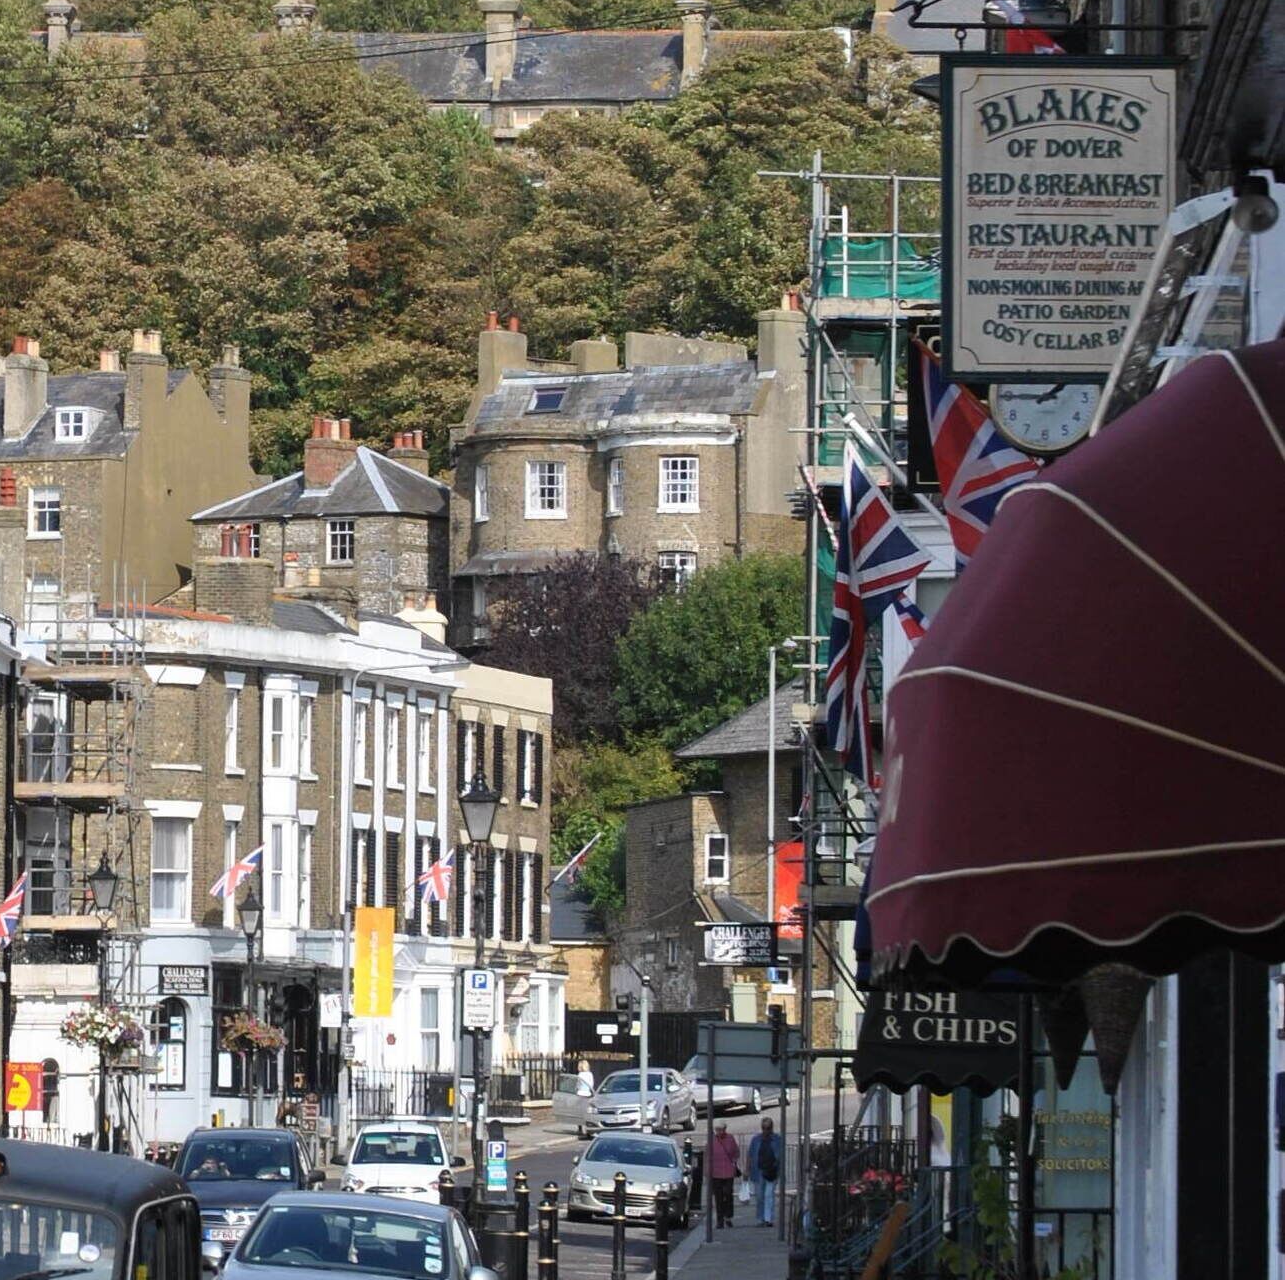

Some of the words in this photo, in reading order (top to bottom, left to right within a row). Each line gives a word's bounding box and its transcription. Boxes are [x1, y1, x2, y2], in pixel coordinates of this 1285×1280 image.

[978, 88, 1148, 136] BLAKES
[1007, 138, 1038, 158] OF
[1045, 136, 1123, 159] DOVER
[967, 173, 1014, 195] BED
[1018, 173, 1033, 195] &
[1035, 174, 1163, 197] BREAKFAST
[967, 197, 1013, 210] Superior
[968, 224, 1159, 247] RESTAURANT
[1075, 281, 1125, 296] DINING
[998, 304, 1053, 320] PATIO
[1059, 305, 1131, 320] GARDEN
[982, 319, 1033, 345] COSY
[1034, 332, 1103, 350] CELLAR
[1081, 392, 1089, 404] 3
[711, 926, 771, 940] CHALLENGER
[162, 967, 205, 978] CHALLENGER
[883, 992, 957, 1014] FISH
[882, 1015, 902, 1039] &
[913, 1017, 1018, 1045] CHIPS
[1036, 1159, 1110, 1170] SOLICITORS
